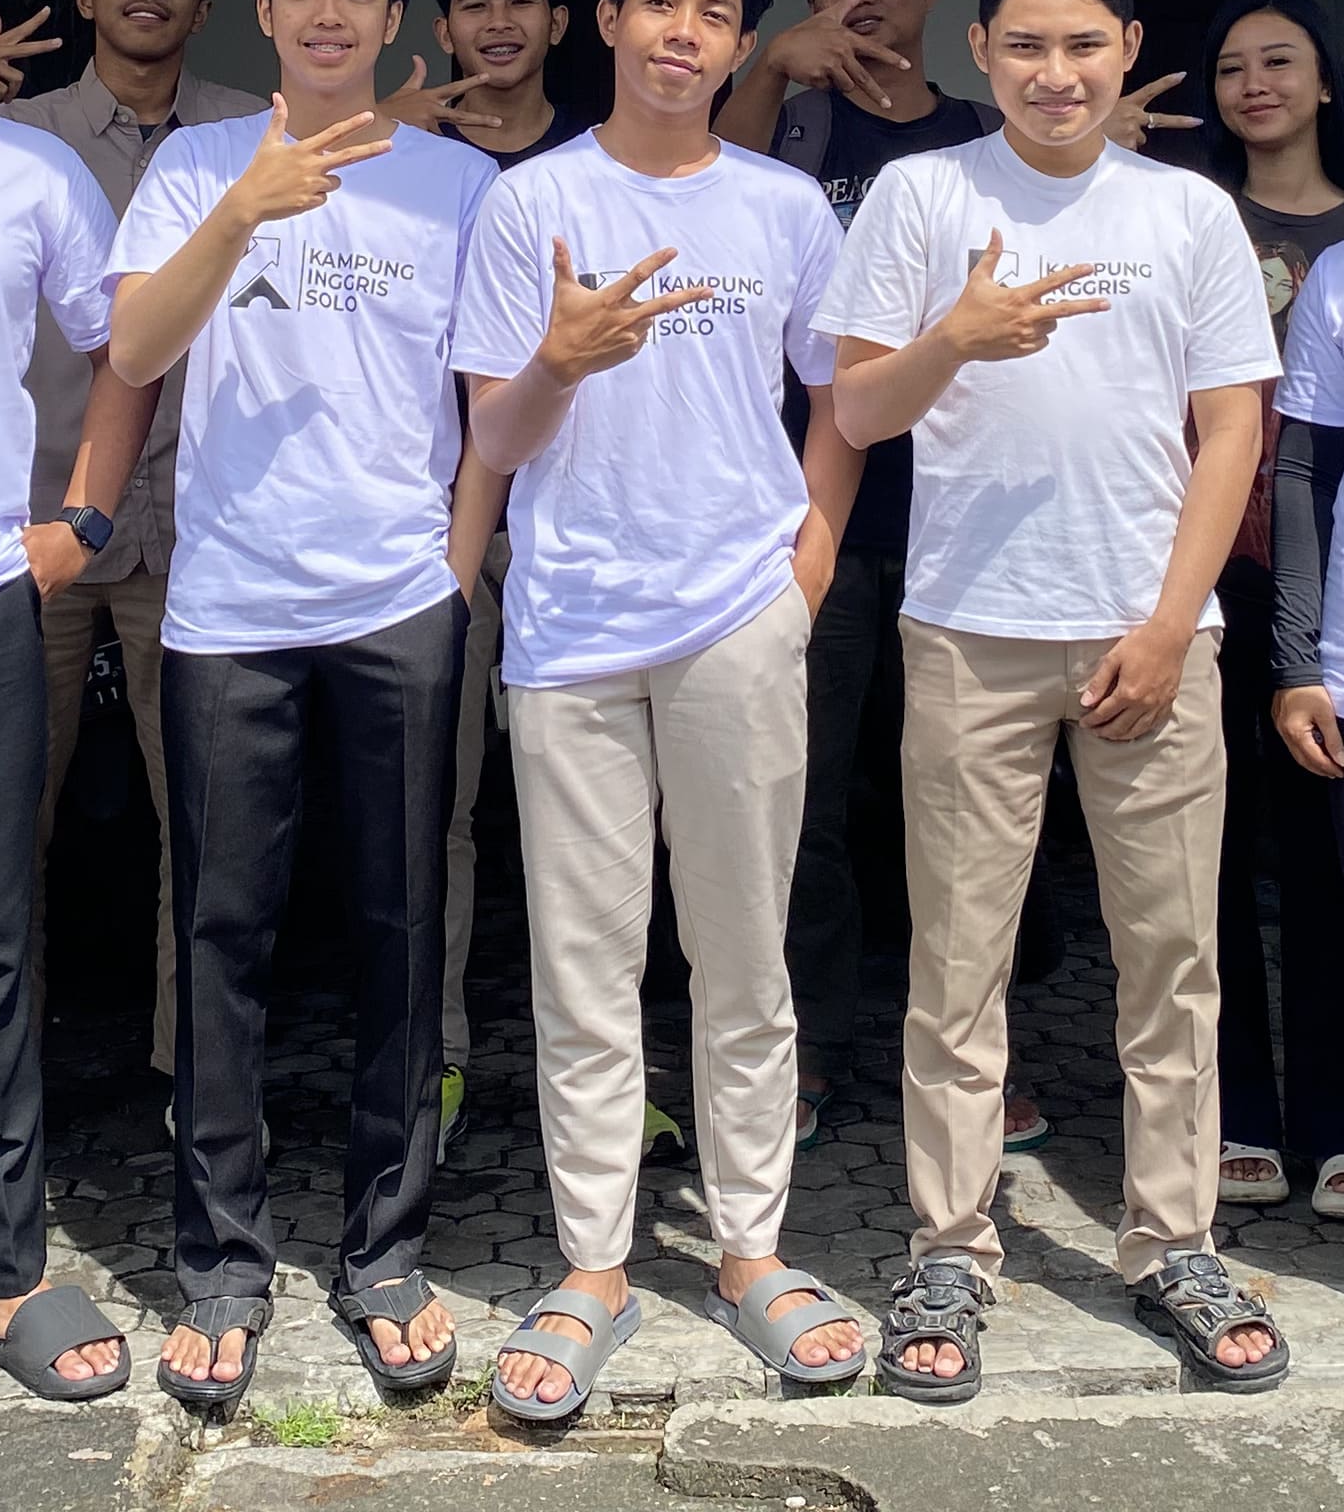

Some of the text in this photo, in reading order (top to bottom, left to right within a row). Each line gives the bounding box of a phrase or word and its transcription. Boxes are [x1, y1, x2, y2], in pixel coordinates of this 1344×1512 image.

[309, 248, 415, 280] KAMPUNG
[1047, 262, 1152, 278] KPUNG
[307, 268, 389, 297] INGGRIS
[1052, 280, 1130, 296] NGGRIS
[304, 290, 357, 312] SOLO
[659, 318, 714, 336] SOLO
